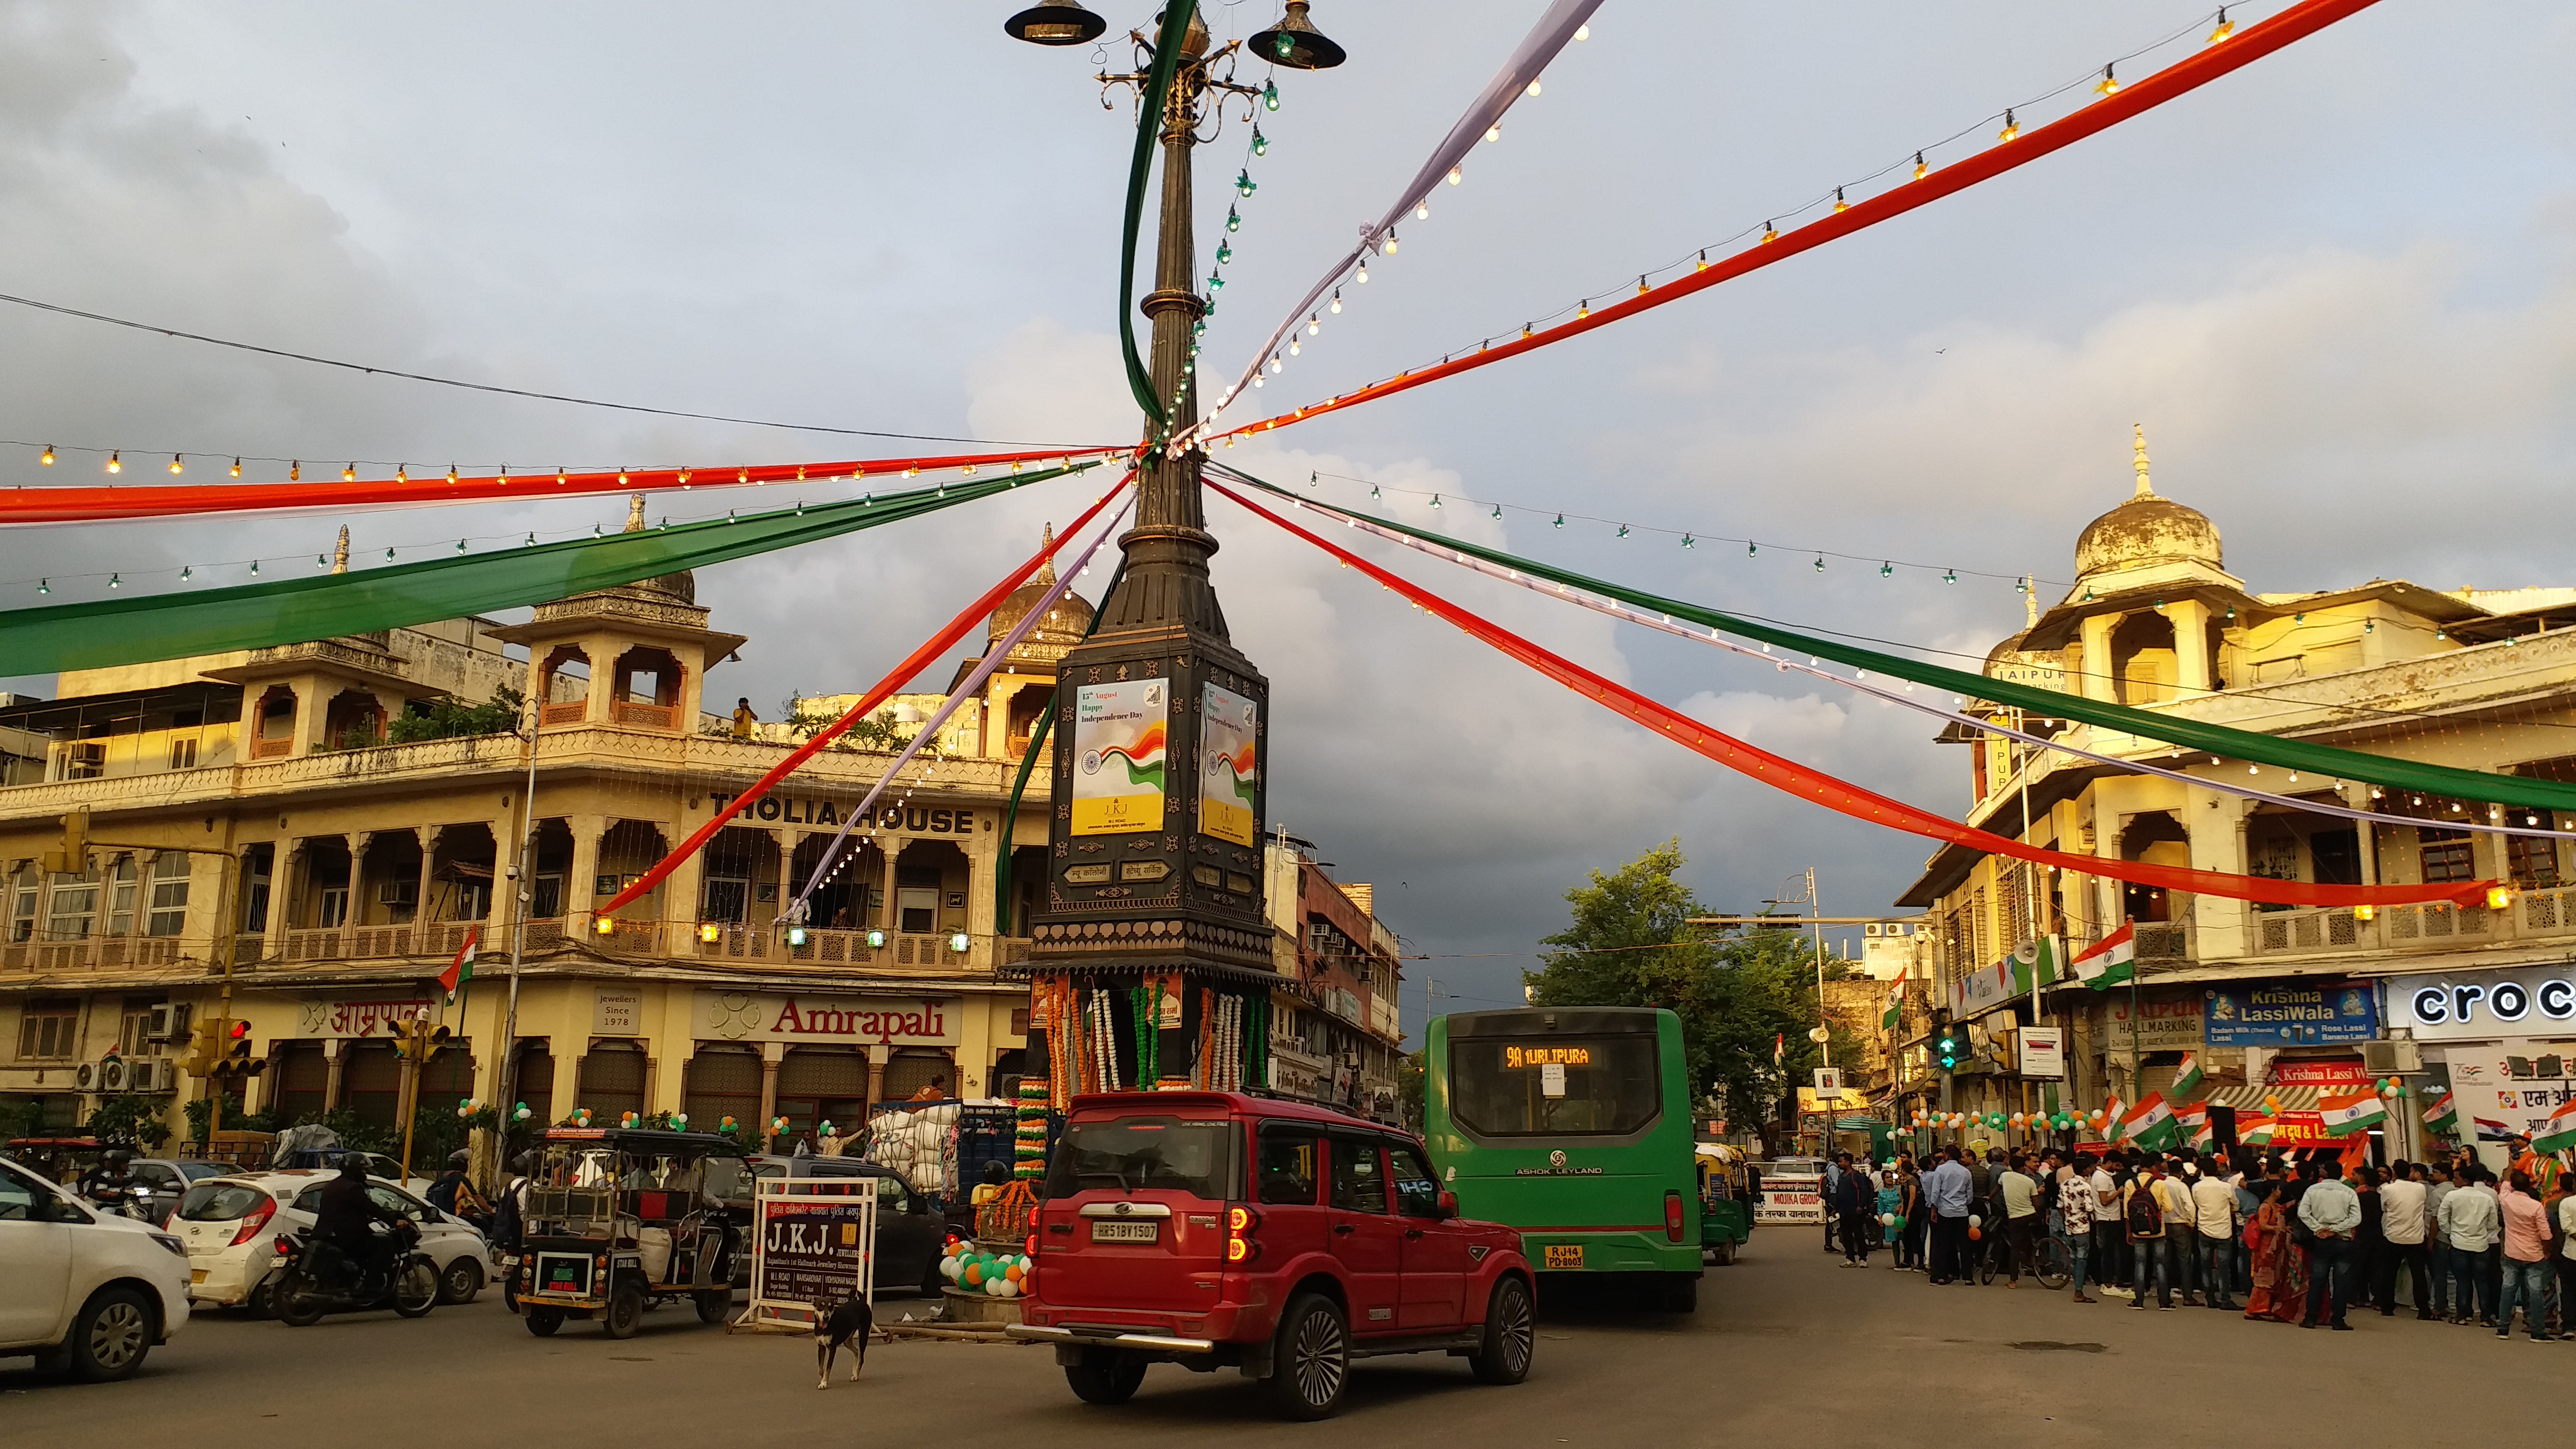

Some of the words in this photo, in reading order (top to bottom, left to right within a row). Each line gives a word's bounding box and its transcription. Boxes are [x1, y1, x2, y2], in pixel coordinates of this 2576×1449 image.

[1095, 691, 1117, 700] August
[1082, 704, 1104, 713] Happy
[1081, 713, 1129, 723] Independence
[710, 792, 839, 826] THOLIA
[854, 803, 974, 834] HOUSE
[1083, 866, 1107, 876] कॉलोनी
[1144, 864, 1163, 874] सर्किल
[600, 995, 636, 1004] Jewellers
[2241, 1006, 2334, 1022] LassiWala
[770, 1000, 945, 1044] Amrapali
[2119, 1020, 2196, 1034] HALLMARKING
[1507, 1046, 1522, 1067] 9A
[2283, 1068, 2324, 1081] Krishna
[2326, 1067, 2353, 1080] Lassi
[2287, 1124, 2302, 1144] दूध
[2303, 1125, 2312, 1139] &
[1773, 1194, 1799, 1205] MOJIKA
[1799, 1194, 1820, 1205] GROUP
[770, 1202, 783, 1216] पुलिस
[810, 1206, 828, 1215] यातायात
[831, 1204, 844, 1219] पुलिस
[768, 1223, 834, 1256] J.K.J.
[766, 1257, 790, 1266] Rajasthan's
[797, 1259, 817, 1267] Hallmark
[817, 1260, 837, 1270] Jewellery
[1549, 1257, 1582, 1266] PD-8003
[778, 1272, 790, 1281] ROAD
[797, 1273, 822, 1283] MANSAROVAR
[846, 1276, 857, 1286] NAGAR
